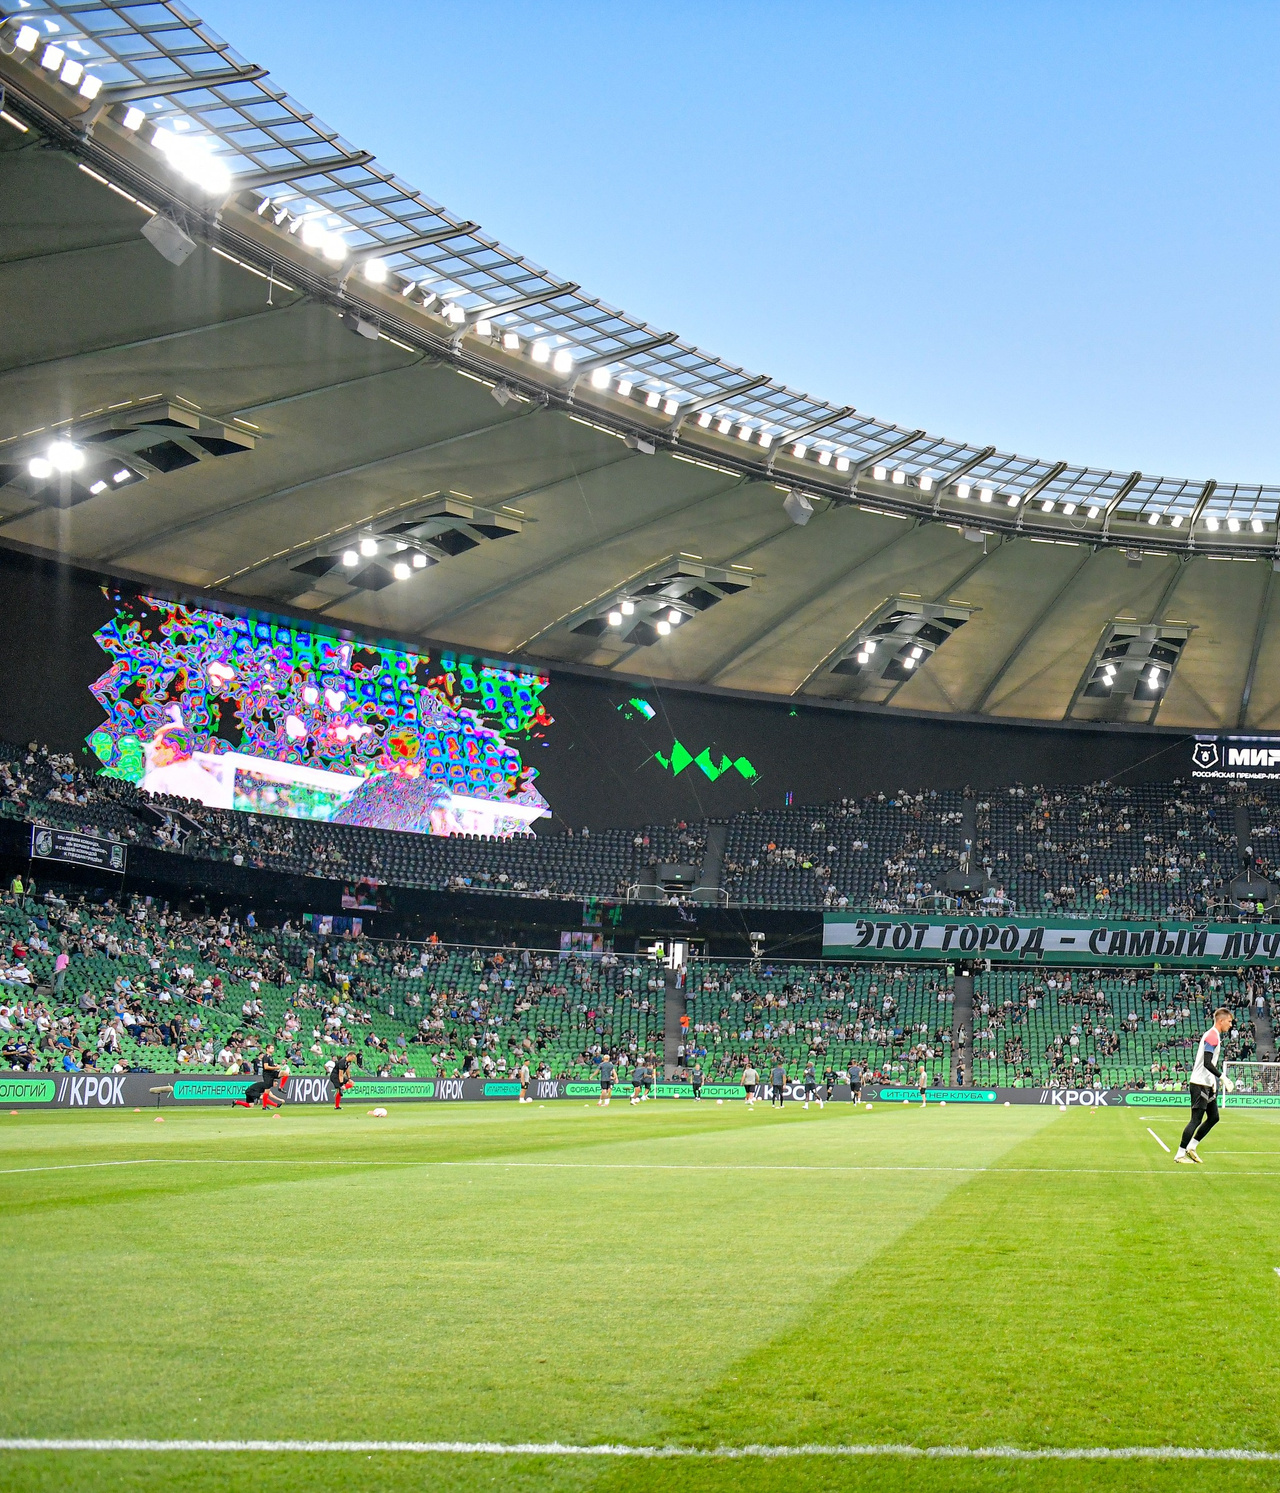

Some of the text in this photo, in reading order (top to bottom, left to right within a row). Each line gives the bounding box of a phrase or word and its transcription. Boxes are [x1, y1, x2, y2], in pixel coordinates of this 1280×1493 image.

[1192, 770, 1235, 779] РОССИЙСКАЯ
[854, 919, 930, 951] ЭТОТ
[941, 923, 1046, 961] ГОРОД
[1088, 924, 1209, 958] САМЫЙ
[178, 1085, 249, 1095] ИТ-ПАРТНЕР КЛУБ
[666, 1086, 740, 1095] ТЕХНЛОГИЙ
[1132, 1095, 1182, 1104] ФОРВАРД
